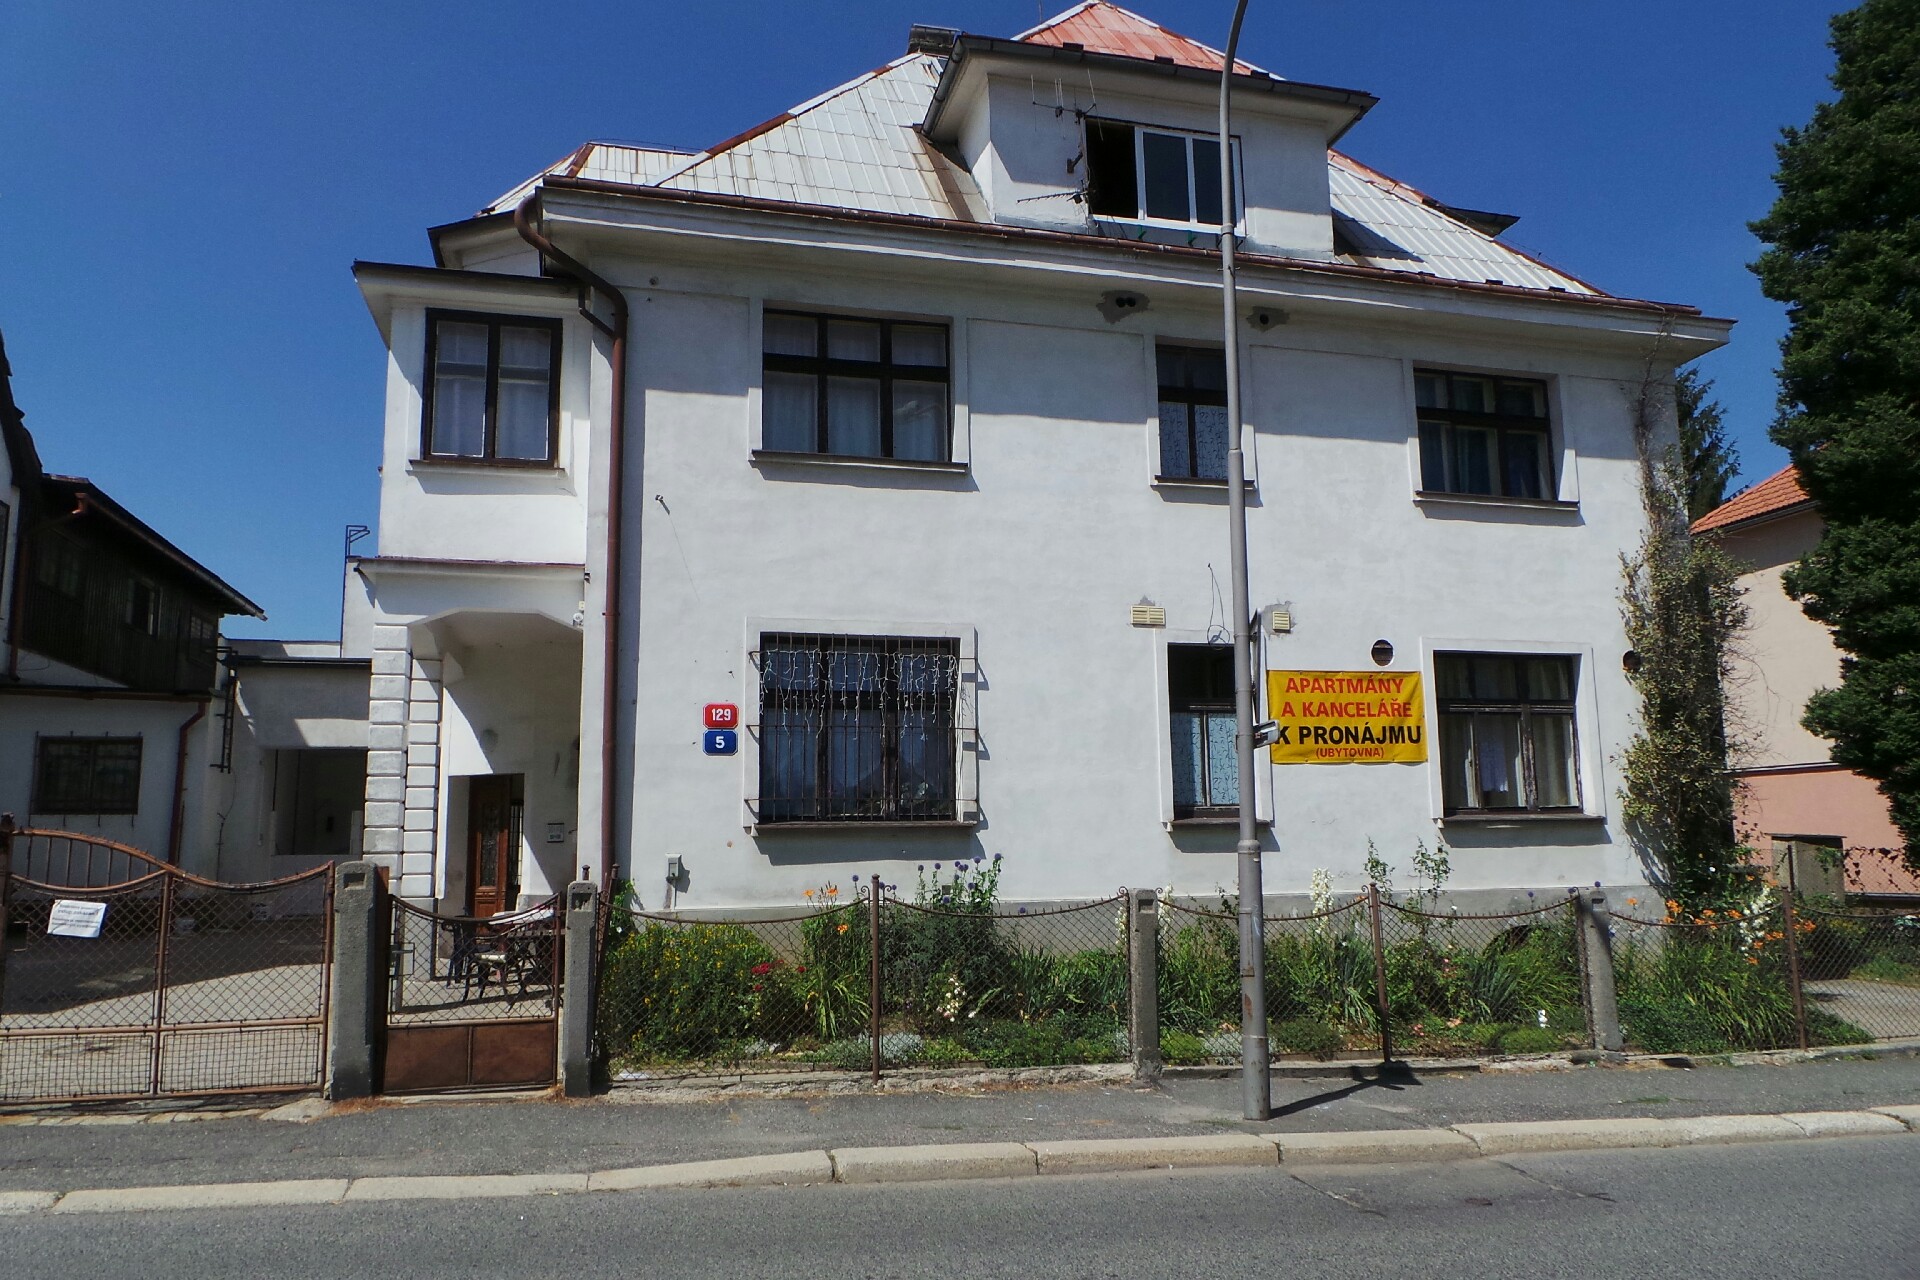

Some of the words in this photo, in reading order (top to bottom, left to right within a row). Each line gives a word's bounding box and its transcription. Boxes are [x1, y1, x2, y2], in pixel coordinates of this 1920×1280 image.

[1285, 675, 1404, 694] APARTMÁNY
[711, 708, 731, 721] 129
[1281, 702, 1296, 717] A
[1302, 699, 1413, 718] KANCELÁŘE
[1274, 725, 1291, 745] K
[1299, 722, 1421, 745] PRONÁJMU
[715, 735, 725, 749] 5
[1316, 747, 1385, 759] (UBYTOVNA)
